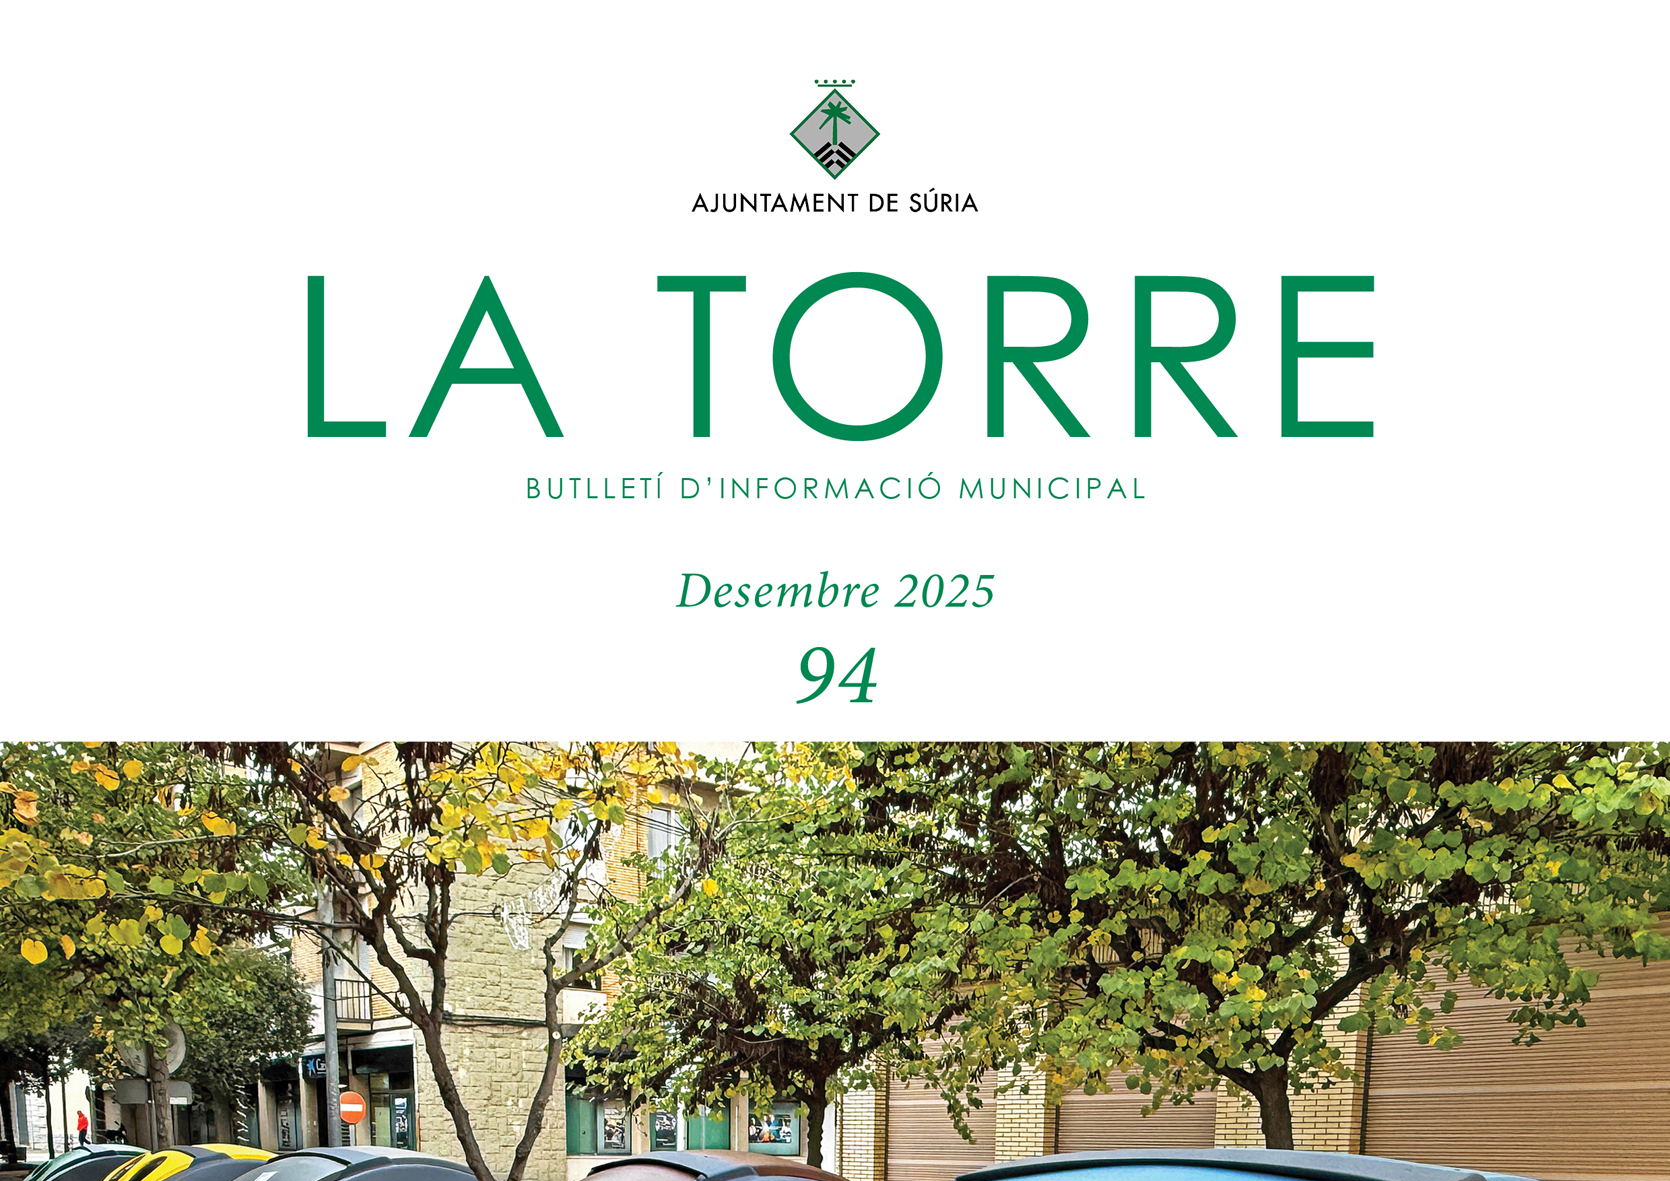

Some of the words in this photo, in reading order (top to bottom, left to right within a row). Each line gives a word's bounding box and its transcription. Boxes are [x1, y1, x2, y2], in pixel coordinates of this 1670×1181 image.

[692, 193, 858, 212] AJUNTAMENT
[870, 194, 898, 212] DE
[910, 188, 978, 212] SÚRIA
[308, 276, 564, 437] LA
[657, 272, 1374, 441] TORRE
[528, 472, 663, 499] BUTLLETÍ
[682, 472, 940, 499] D’INFORMACIÓ
[960, 477, 1145, 499] MUNICIPAL
[676, 571, 879, 608] Desembre
[894, 574, 995, 608] 2025
[796, 647, 877, 704] 94
